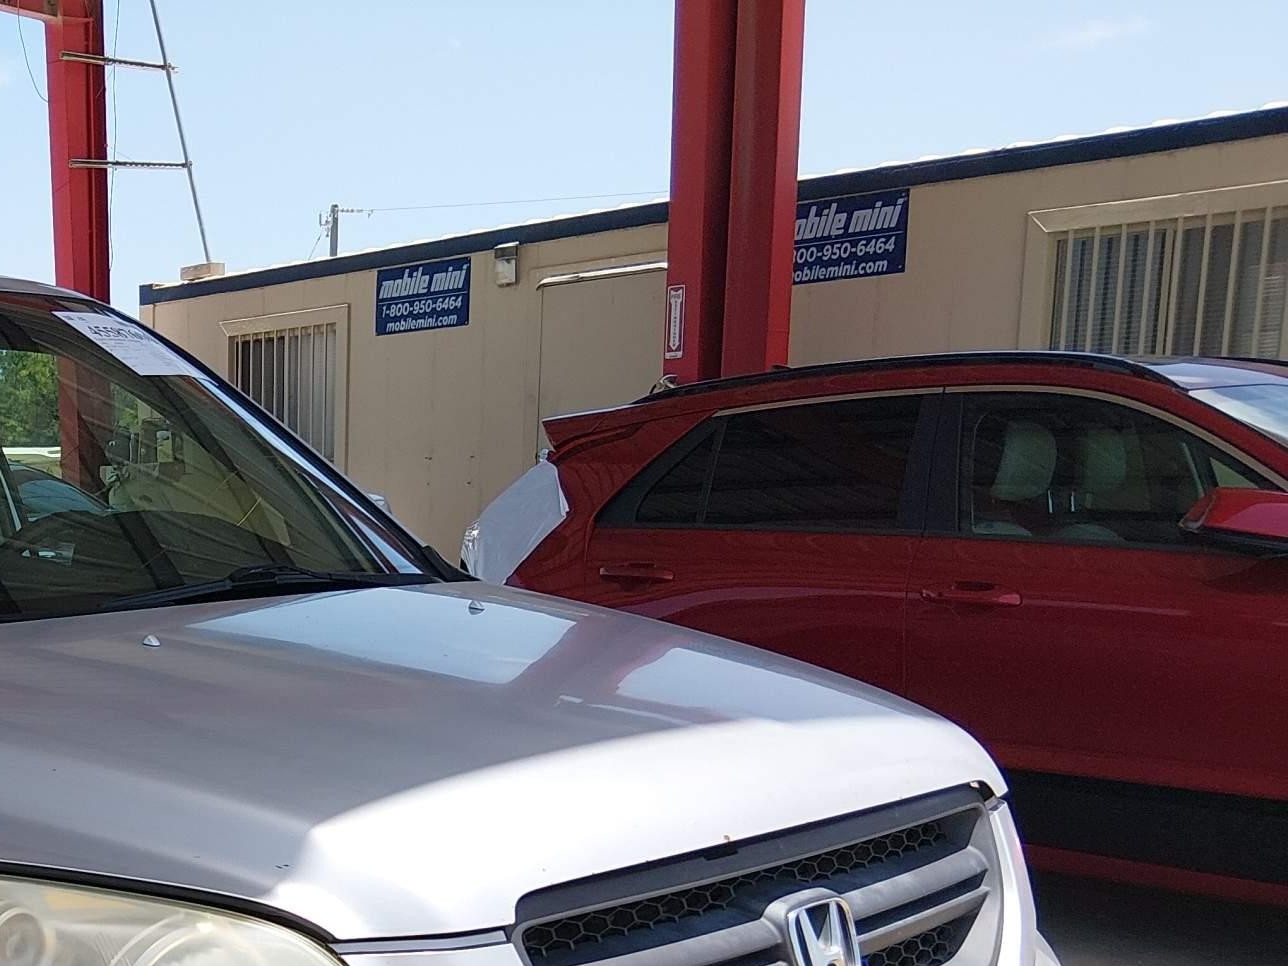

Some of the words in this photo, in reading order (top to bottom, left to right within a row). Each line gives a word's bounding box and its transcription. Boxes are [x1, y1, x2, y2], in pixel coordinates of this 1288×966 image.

[794, 203, 847, 241] obile
[848, 198, 904, 233] mini
[378, 267, 429, 299] mobile
[431, 264, 467, 292] mini
[792, 260, 888, 282] obilemini.com
[382, 296, 462, 318] 1-800-950-6464
[386, 315, 457, 333] mobilemini.com
